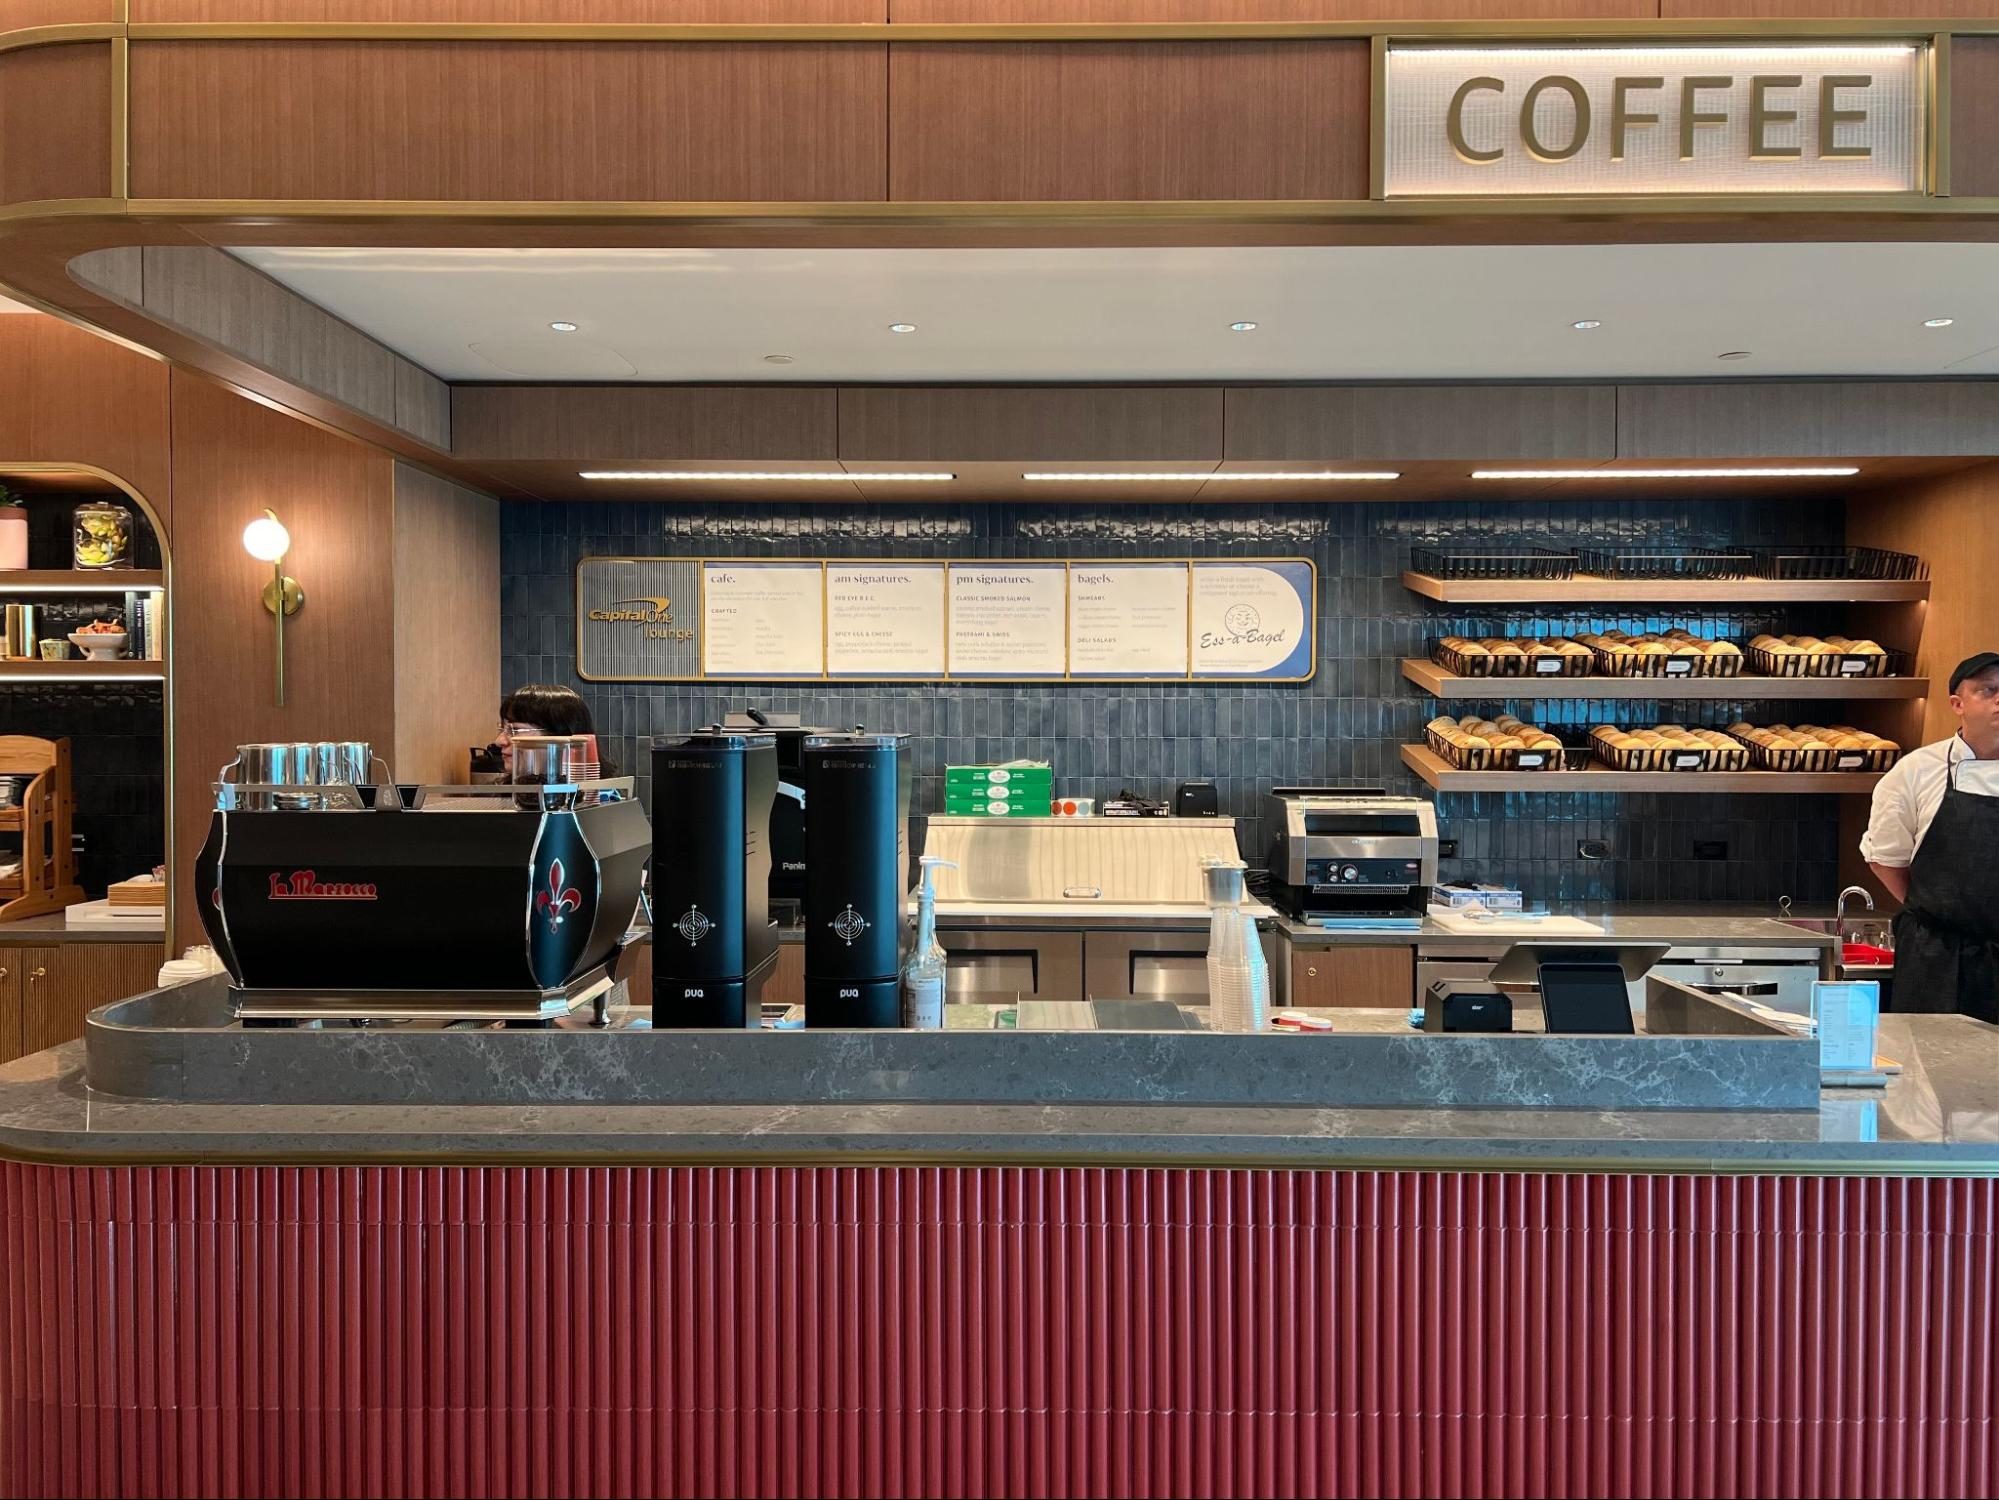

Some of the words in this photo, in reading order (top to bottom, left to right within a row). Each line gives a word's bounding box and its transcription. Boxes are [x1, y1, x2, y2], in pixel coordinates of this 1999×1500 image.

[1446, 75, 1873, 165] COFFEE
[711, 573, 736, 584] cafe.
[834, 575, 851, 583] am
[853, 573, 912, 585] signatures.
[956, 575, 973, 586] pm
[976, 574, 1034, 585] signatures.
[1077, 573, 1114, 585] bagels.
[588, 609, 647, 623] Capital
[645, 625, 694, 643] lounge
[1200, 629, 1286, 649] Ess-a-Bagel
[782, 861, 806, 871] Panin
[289, 870, 377, 898] Marzocco
